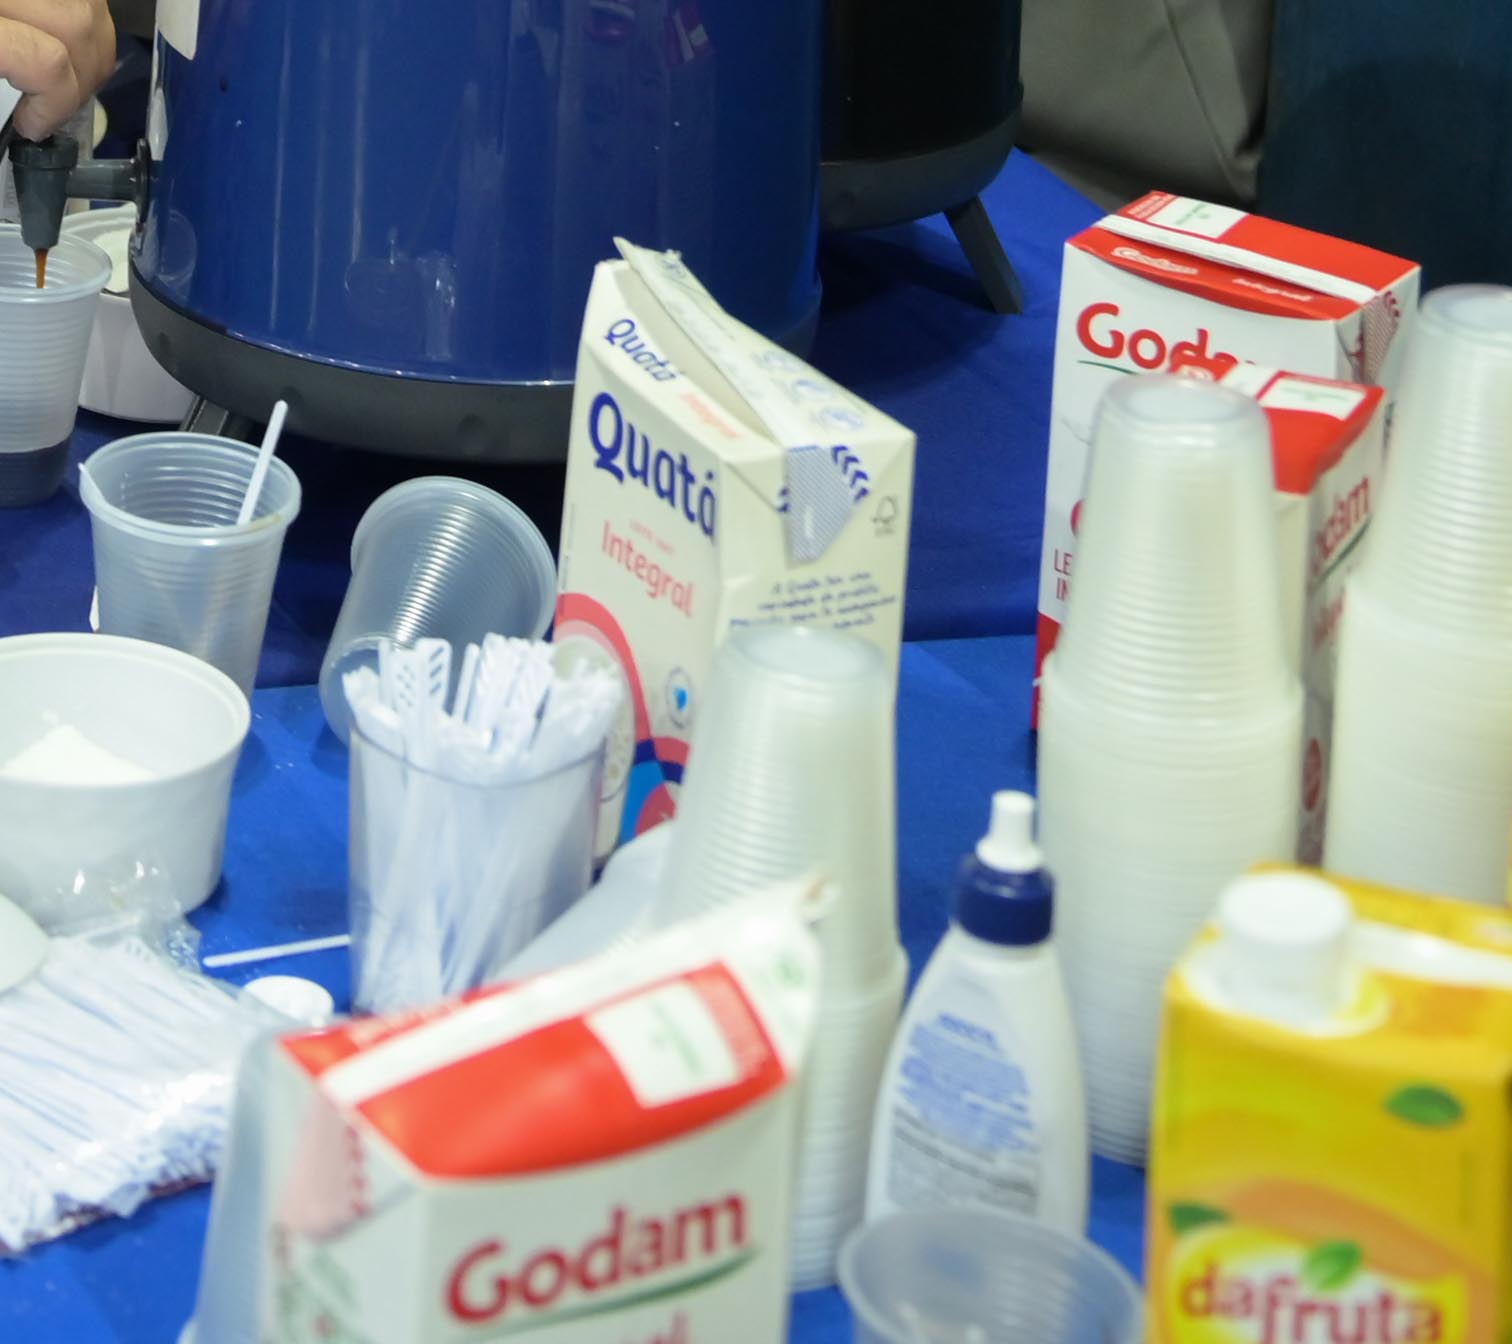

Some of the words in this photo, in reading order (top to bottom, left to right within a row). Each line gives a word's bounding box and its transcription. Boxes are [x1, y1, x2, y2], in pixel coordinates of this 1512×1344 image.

[588, 391, 718, 545] Quatá
[601, 518, 695, 619] Integral
[446, 1192, 746, 1324] Godam
[1179, 1256, 1446, 1344] dafruta
